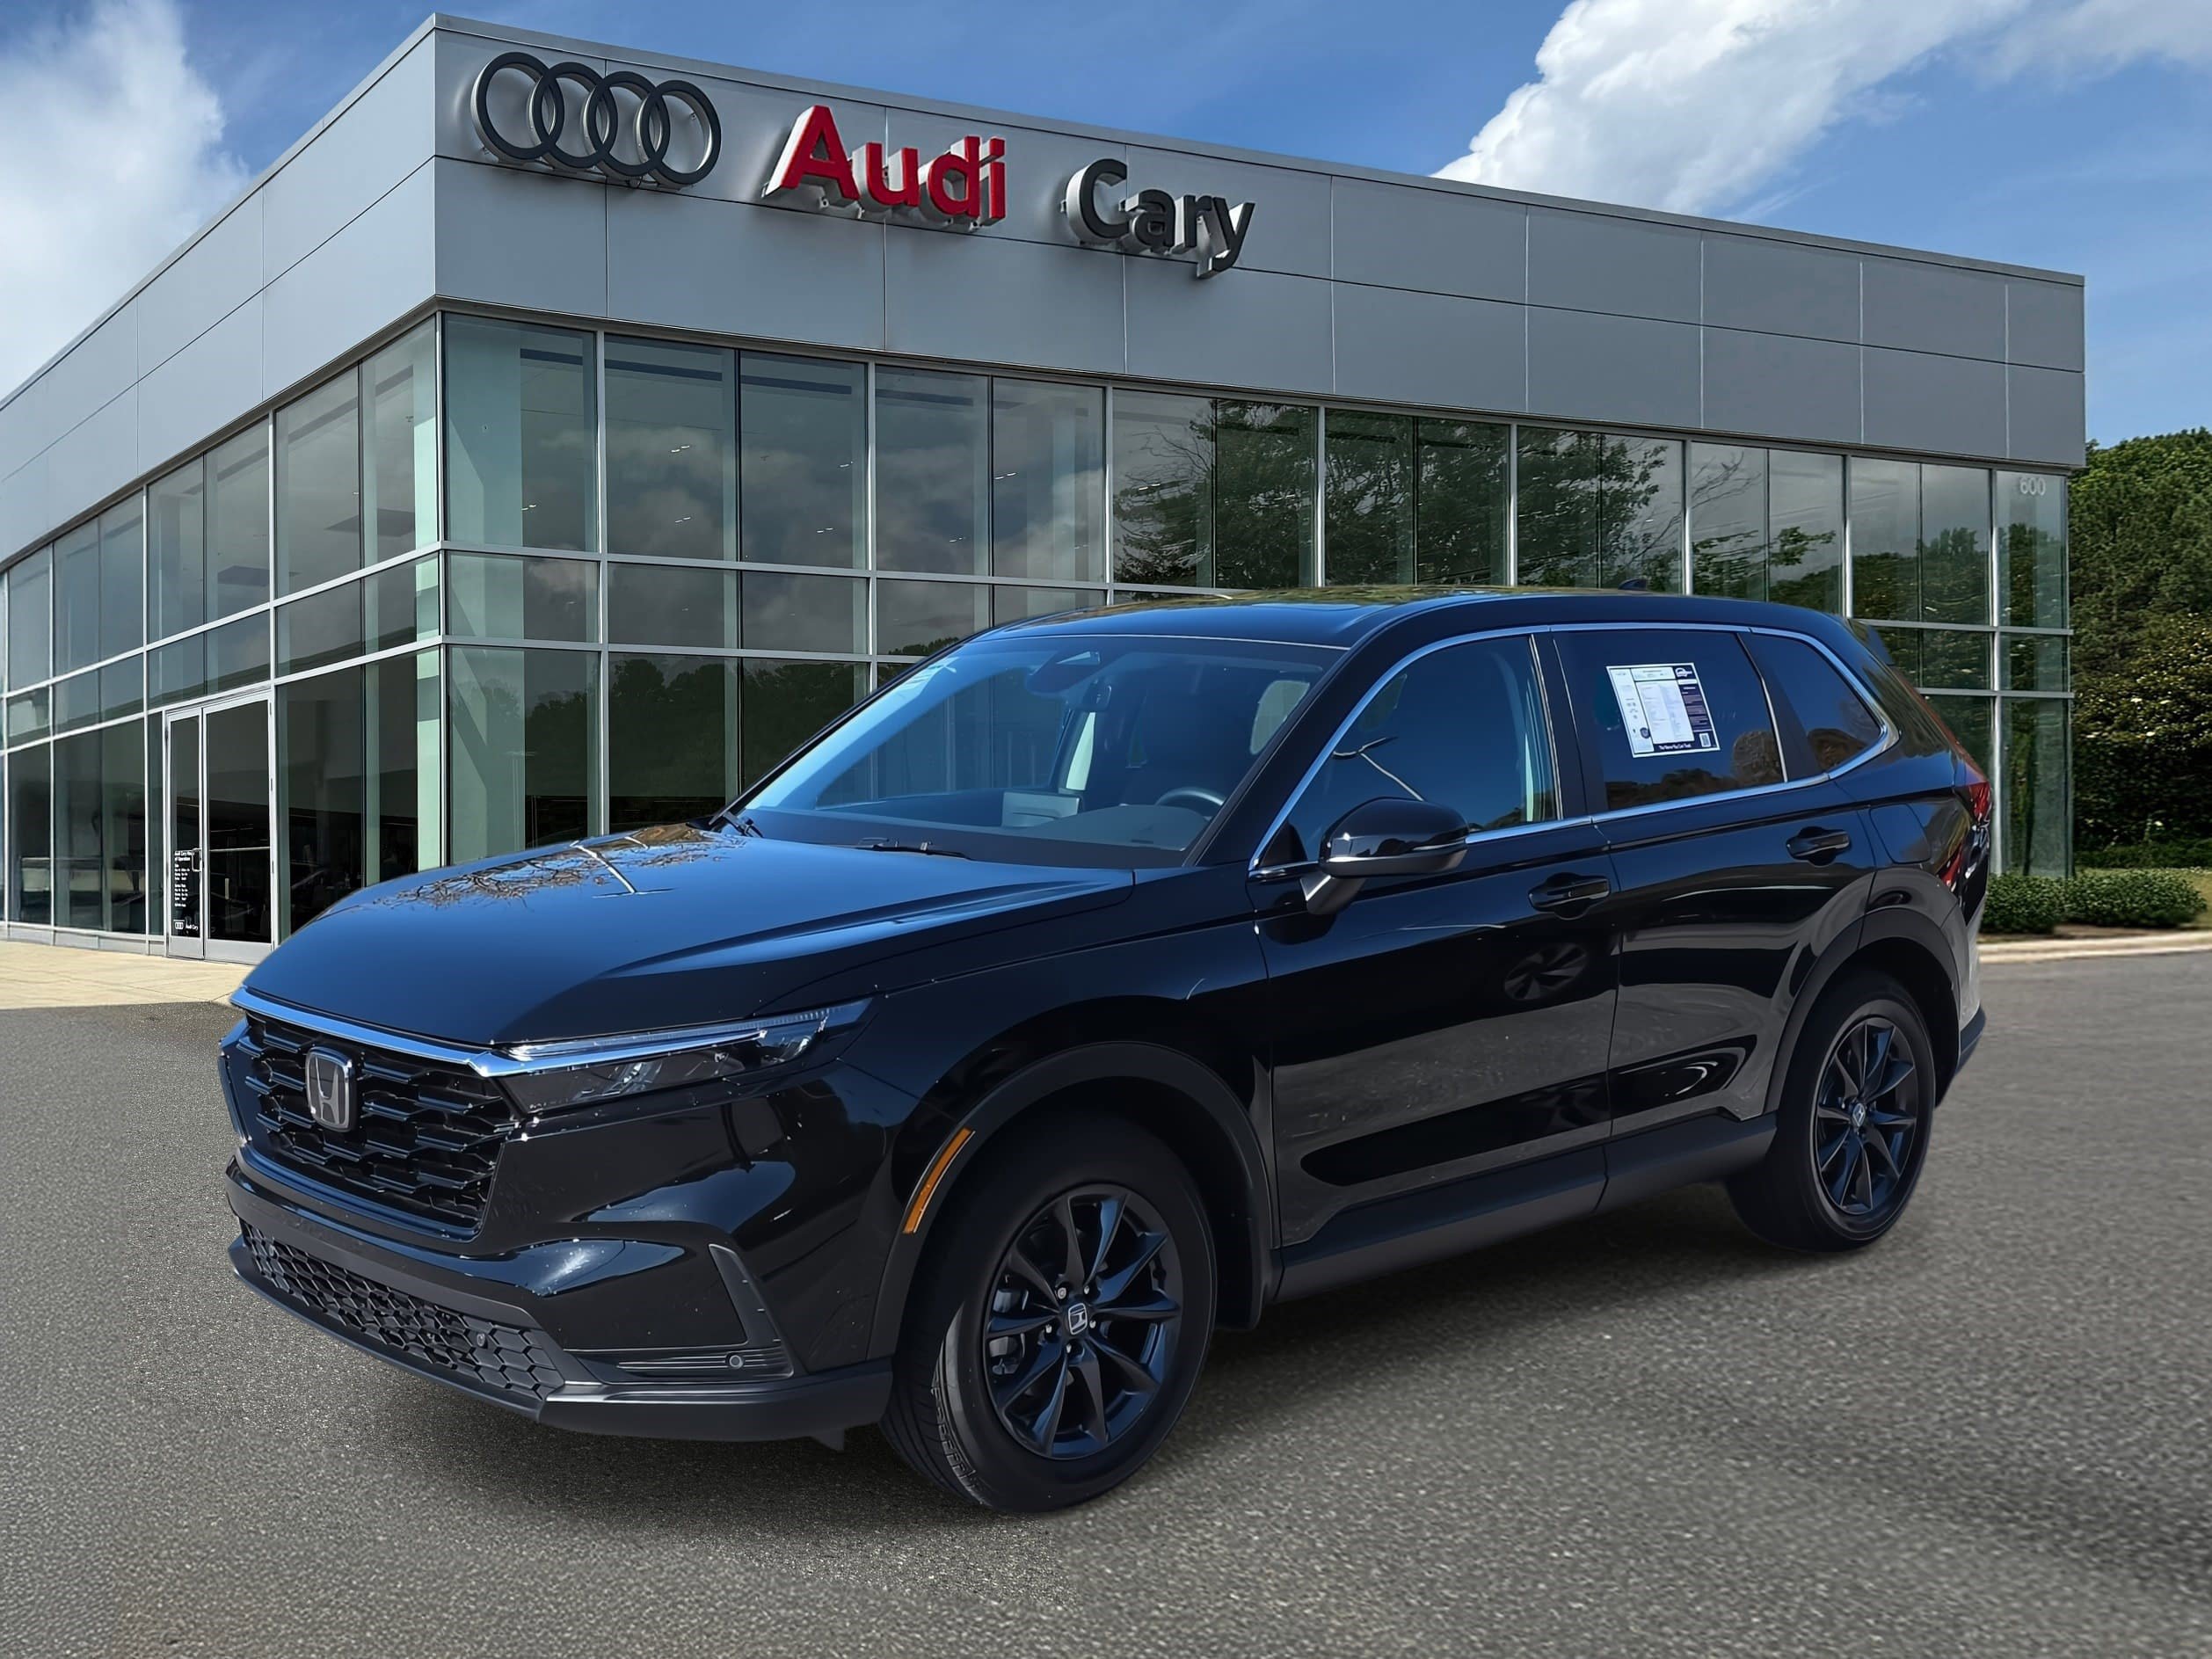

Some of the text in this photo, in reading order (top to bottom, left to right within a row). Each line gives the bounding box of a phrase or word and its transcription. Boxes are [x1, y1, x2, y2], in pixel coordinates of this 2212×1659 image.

[765, 105, 1256, 279] Audi Cary
[2019, 477, 2046, 496] 600
